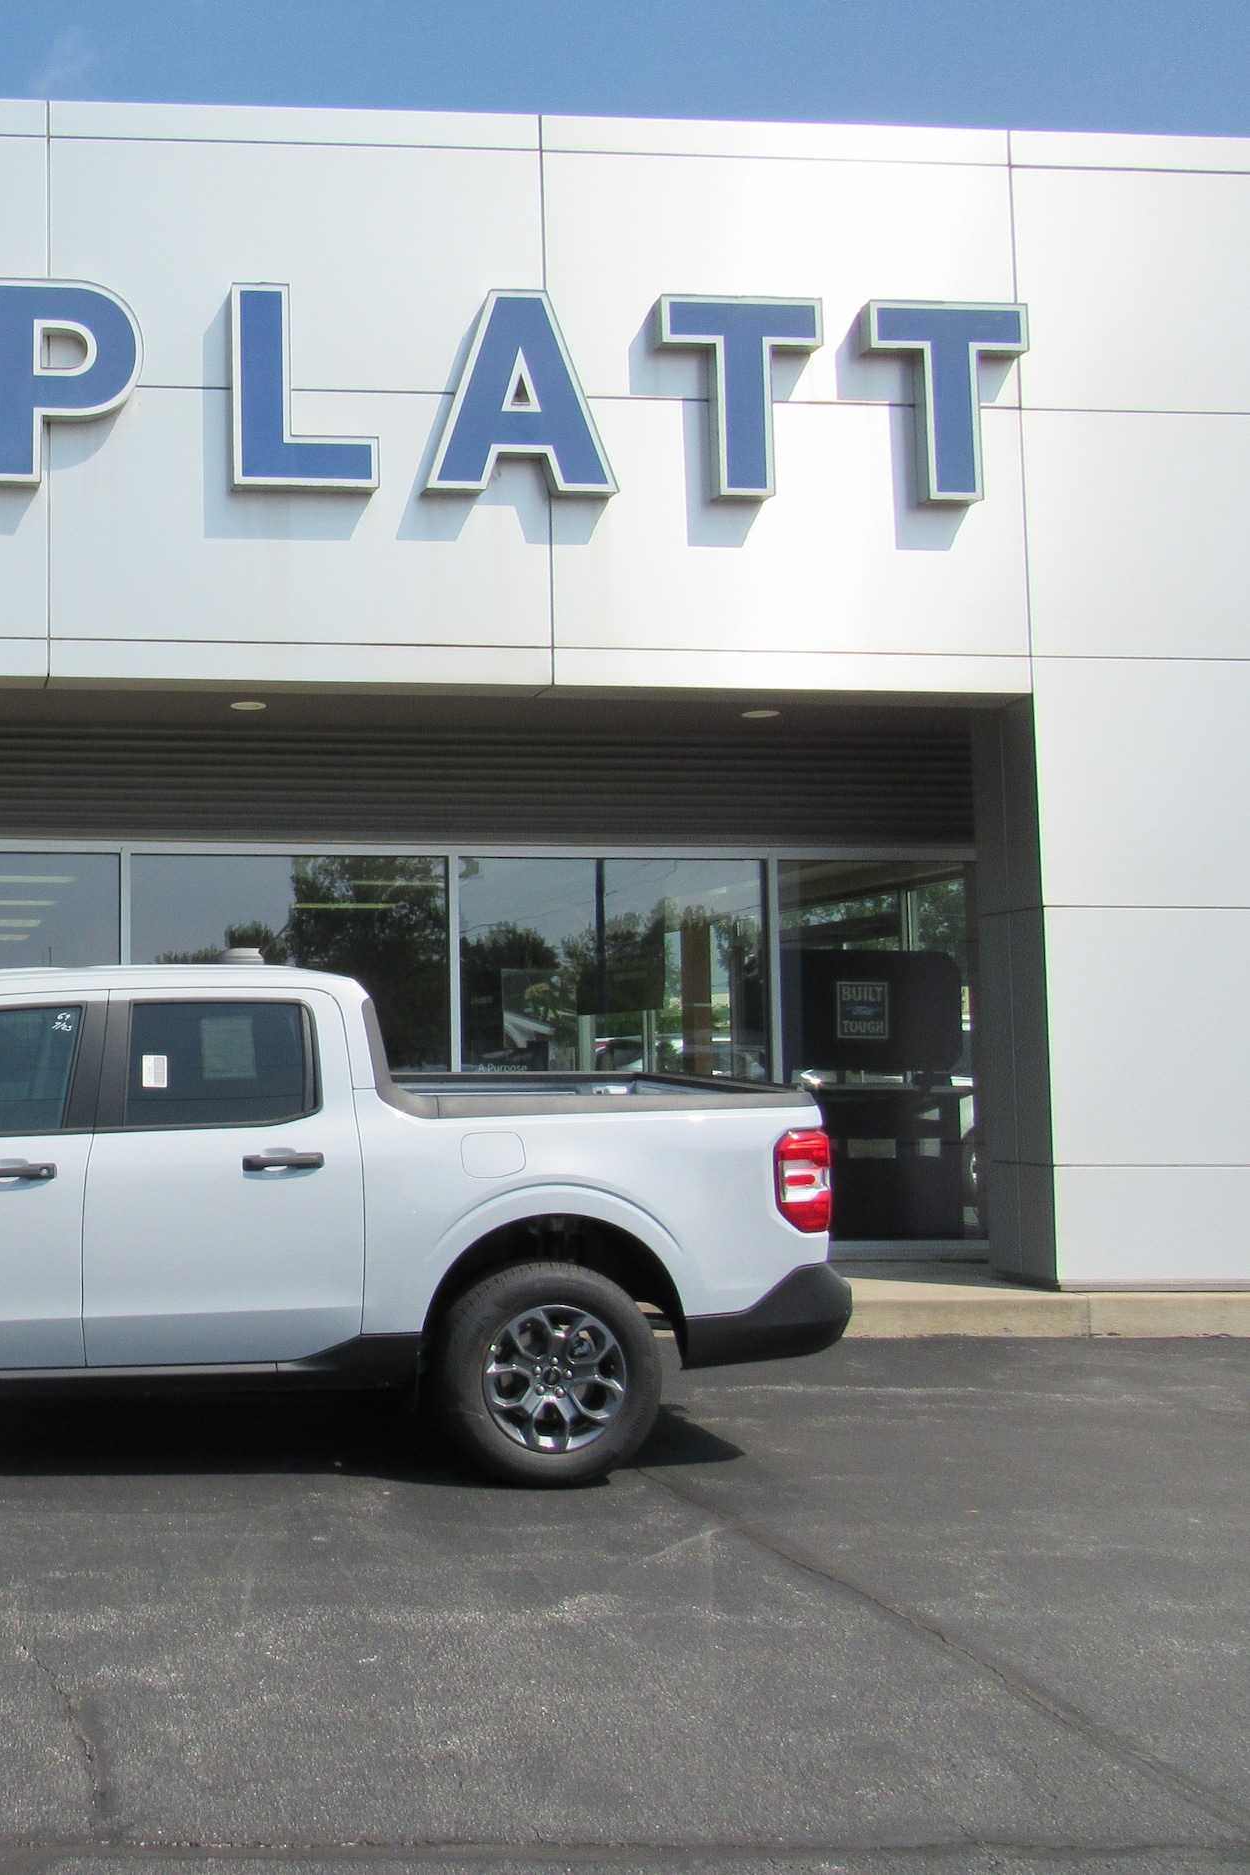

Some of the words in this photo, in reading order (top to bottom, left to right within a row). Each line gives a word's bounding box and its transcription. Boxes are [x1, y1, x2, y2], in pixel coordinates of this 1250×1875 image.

[841, 985, 883, 1002] BUILT
[842, 1020, 885, 1034] TOUGH
[487, 1063, 528, 1072] Purpose
